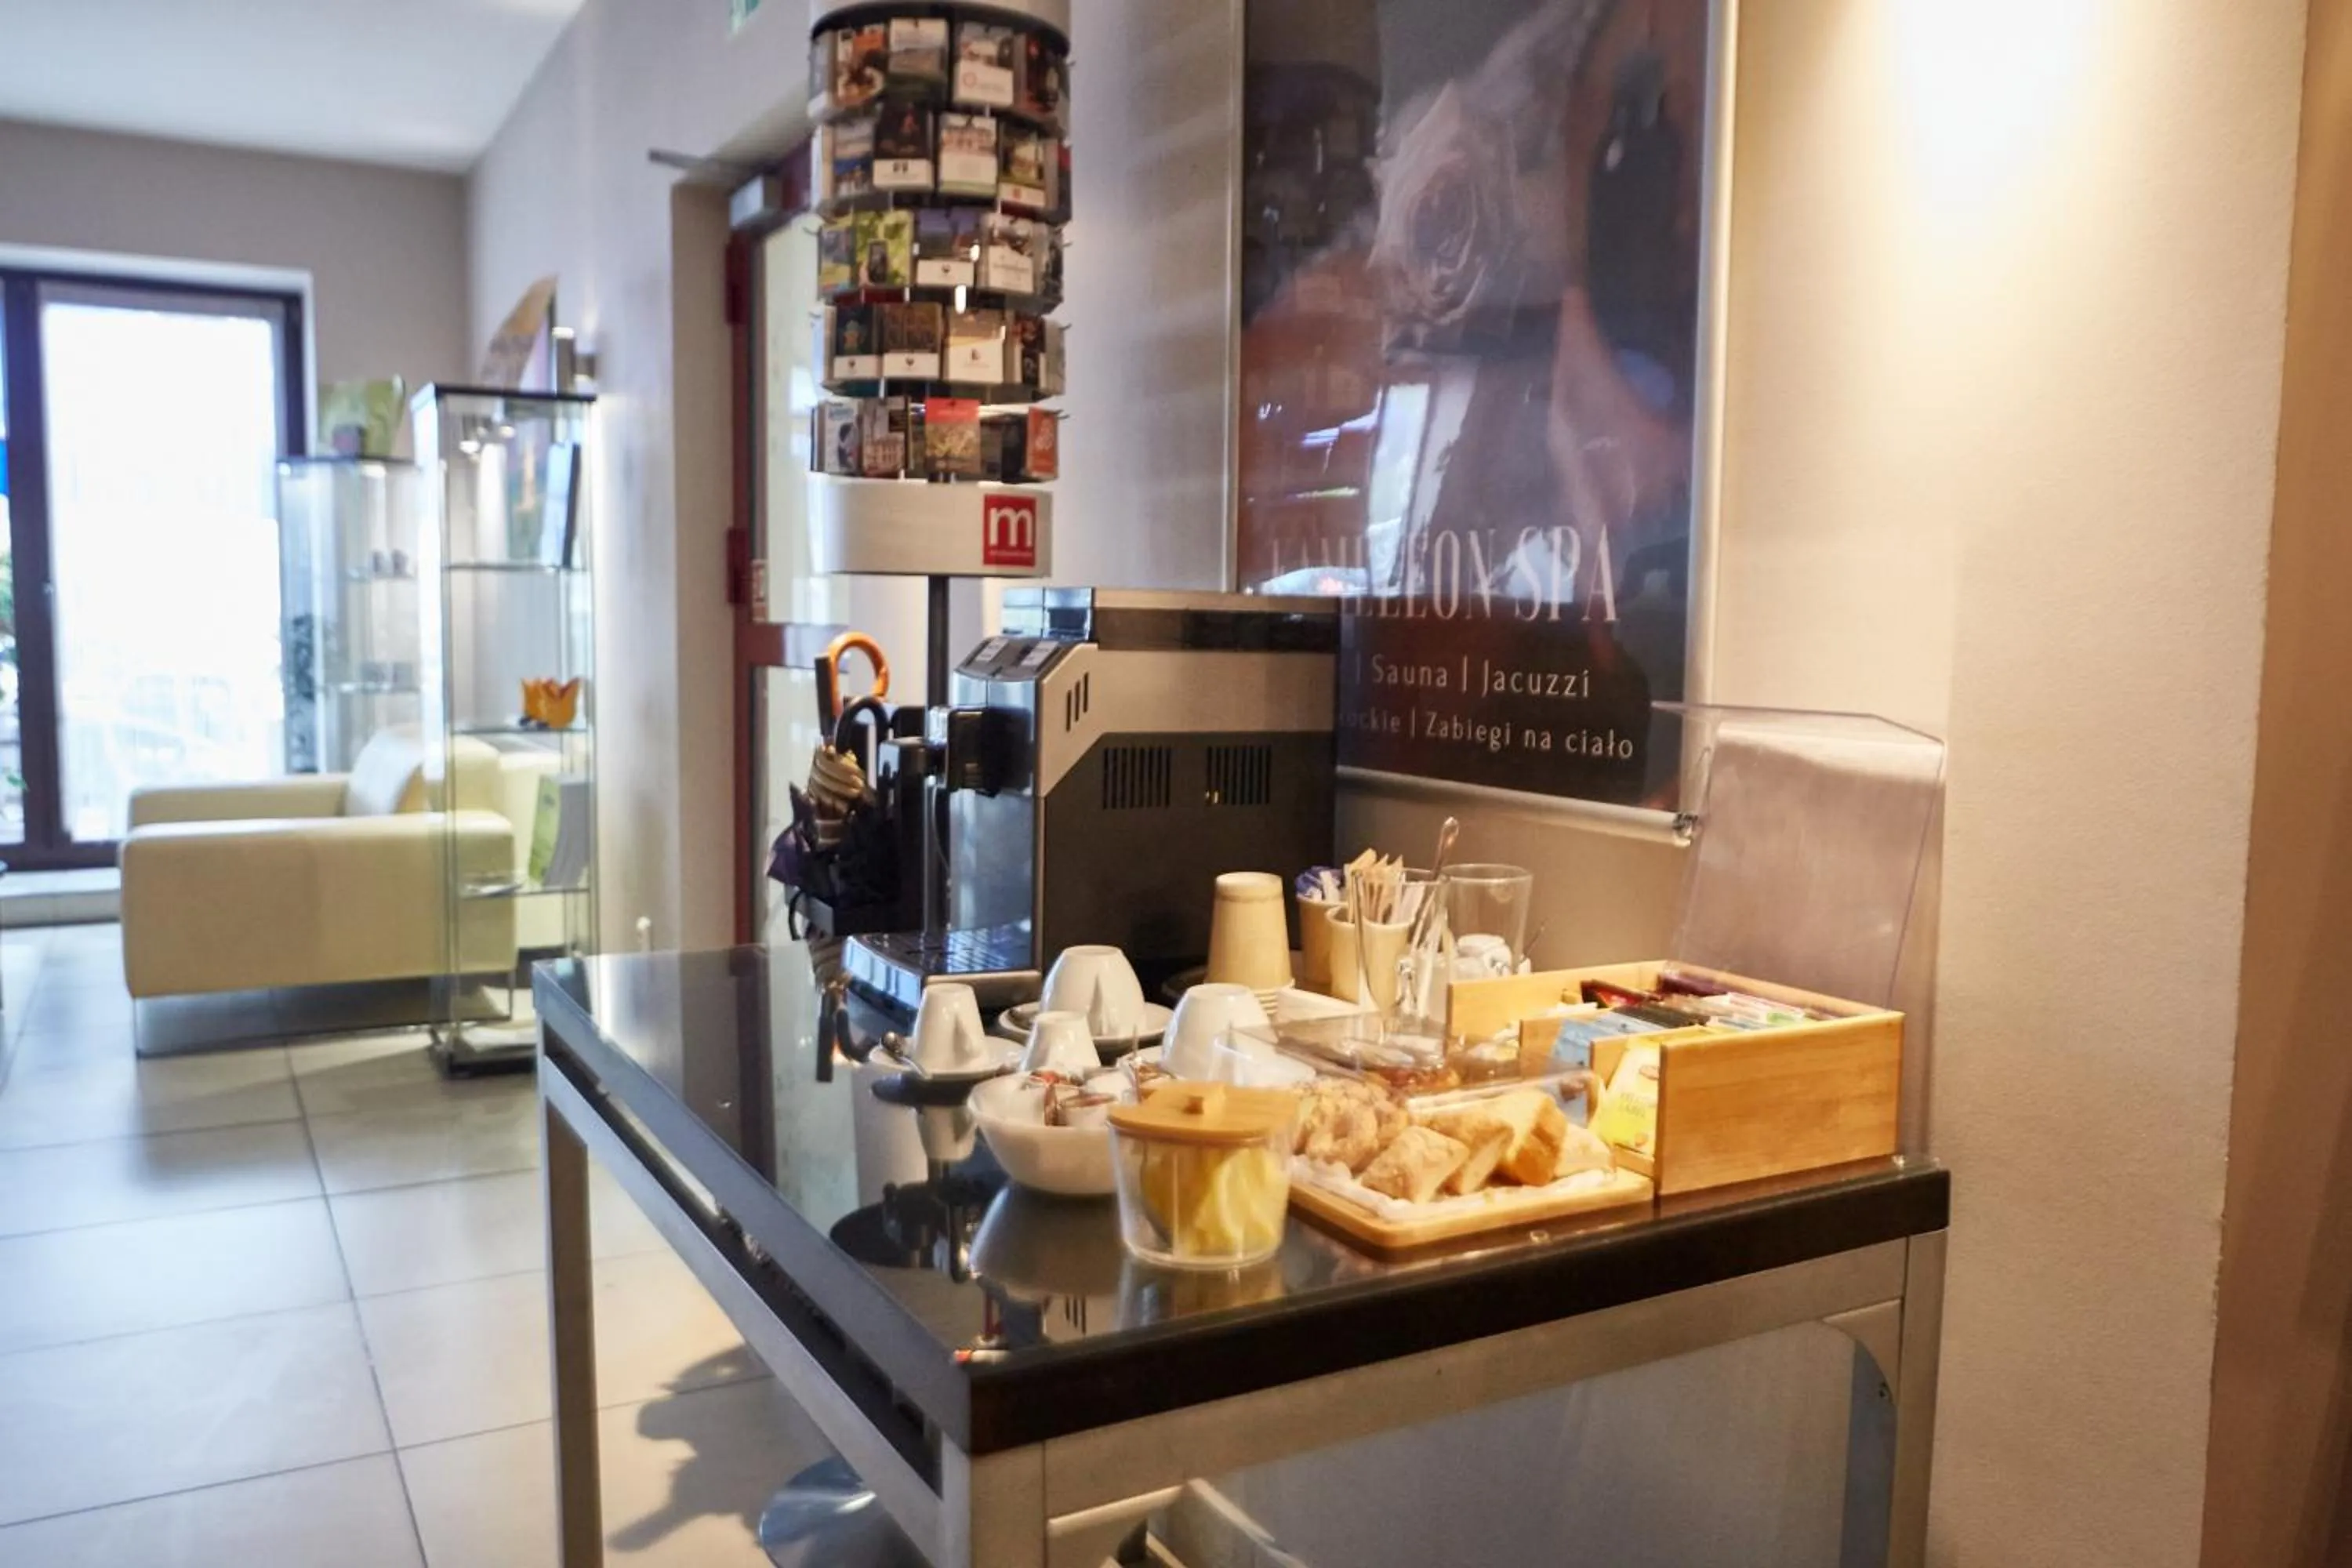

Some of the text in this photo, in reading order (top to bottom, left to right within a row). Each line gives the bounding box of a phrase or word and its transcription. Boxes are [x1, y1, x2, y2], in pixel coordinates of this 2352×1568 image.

[1514, 524, 1620, 622] SPA
[1372, 652, 1448, 688] Sauna
[1481, 659, 1590, 699] Jacuzzi
[1425, 710, 1511, 752] Zabiegi
[1524, 728, 1552, 750] na
[1565, 728, 1634, 760] ciało
